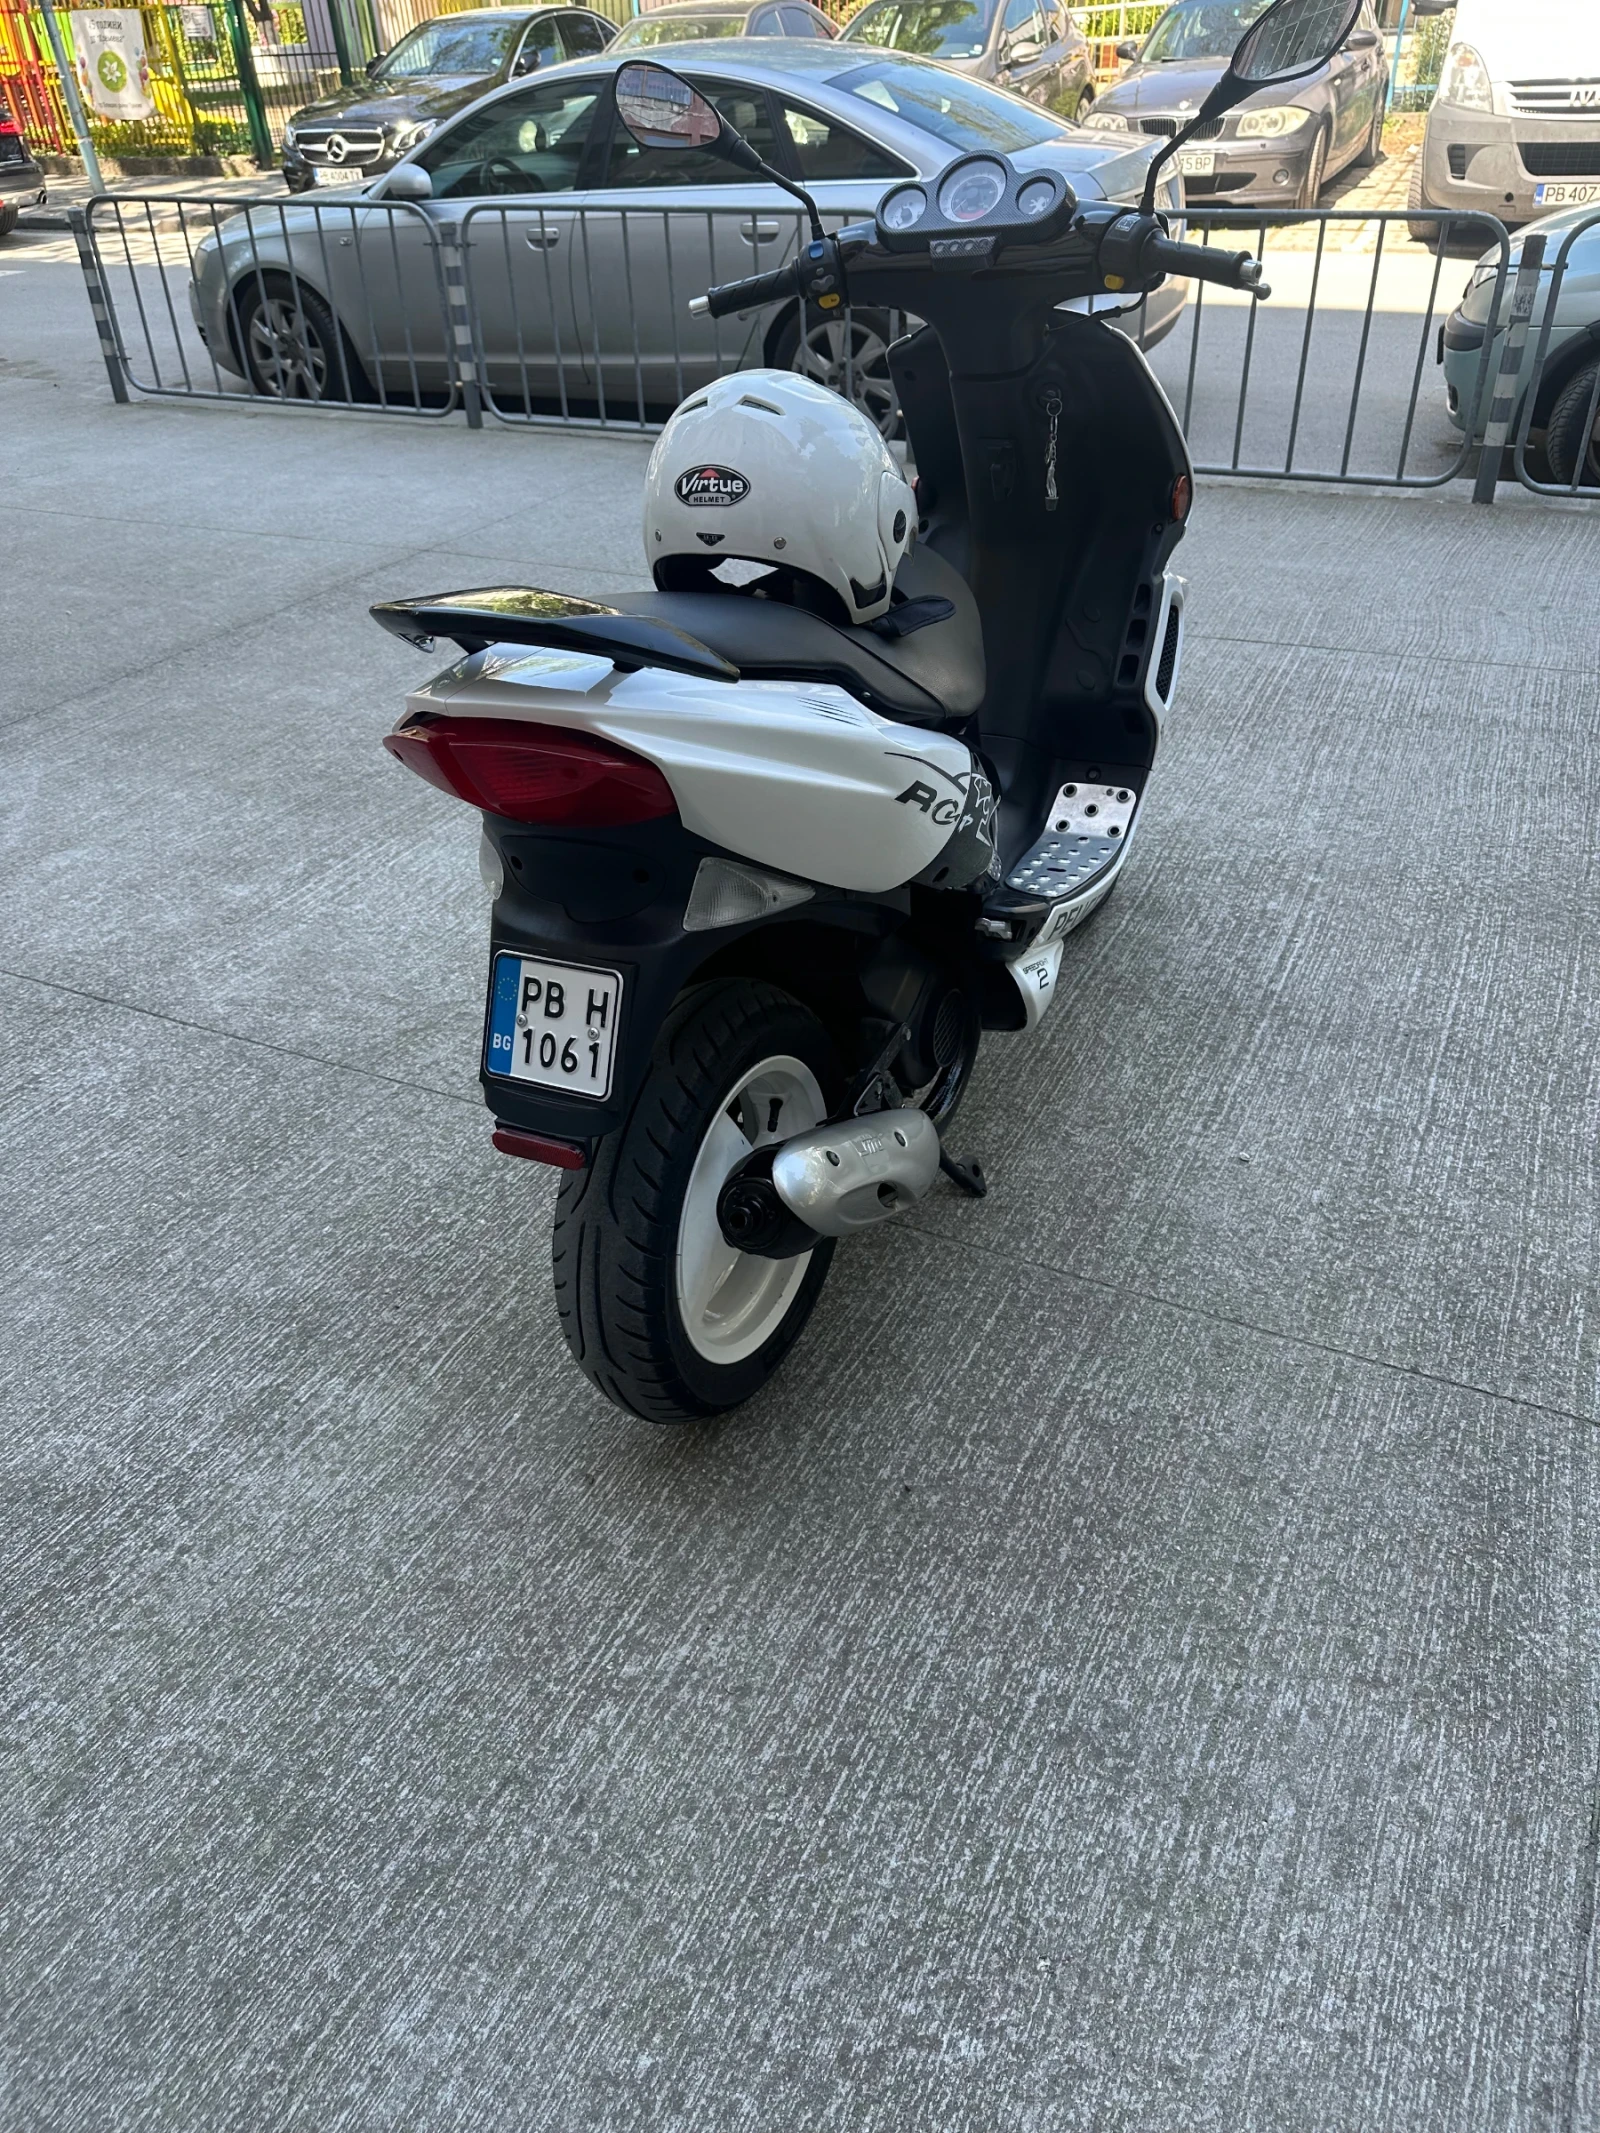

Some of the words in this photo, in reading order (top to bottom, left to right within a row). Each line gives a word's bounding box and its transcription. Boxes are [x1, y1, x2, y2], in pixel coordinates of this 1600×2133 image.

[1545, 187, 1565, 202] PB
[1568, 186, 1600, 202] 407
[681, 473, 744, 496] Virtue
[1036, 967, 1050, 990] 2
[521, 976, 565, 1019] PB
[586, 988, 609, 1028] H
[492, 1032, 512, 1051] BG
[522, 1027, 600, 1078] 1061
